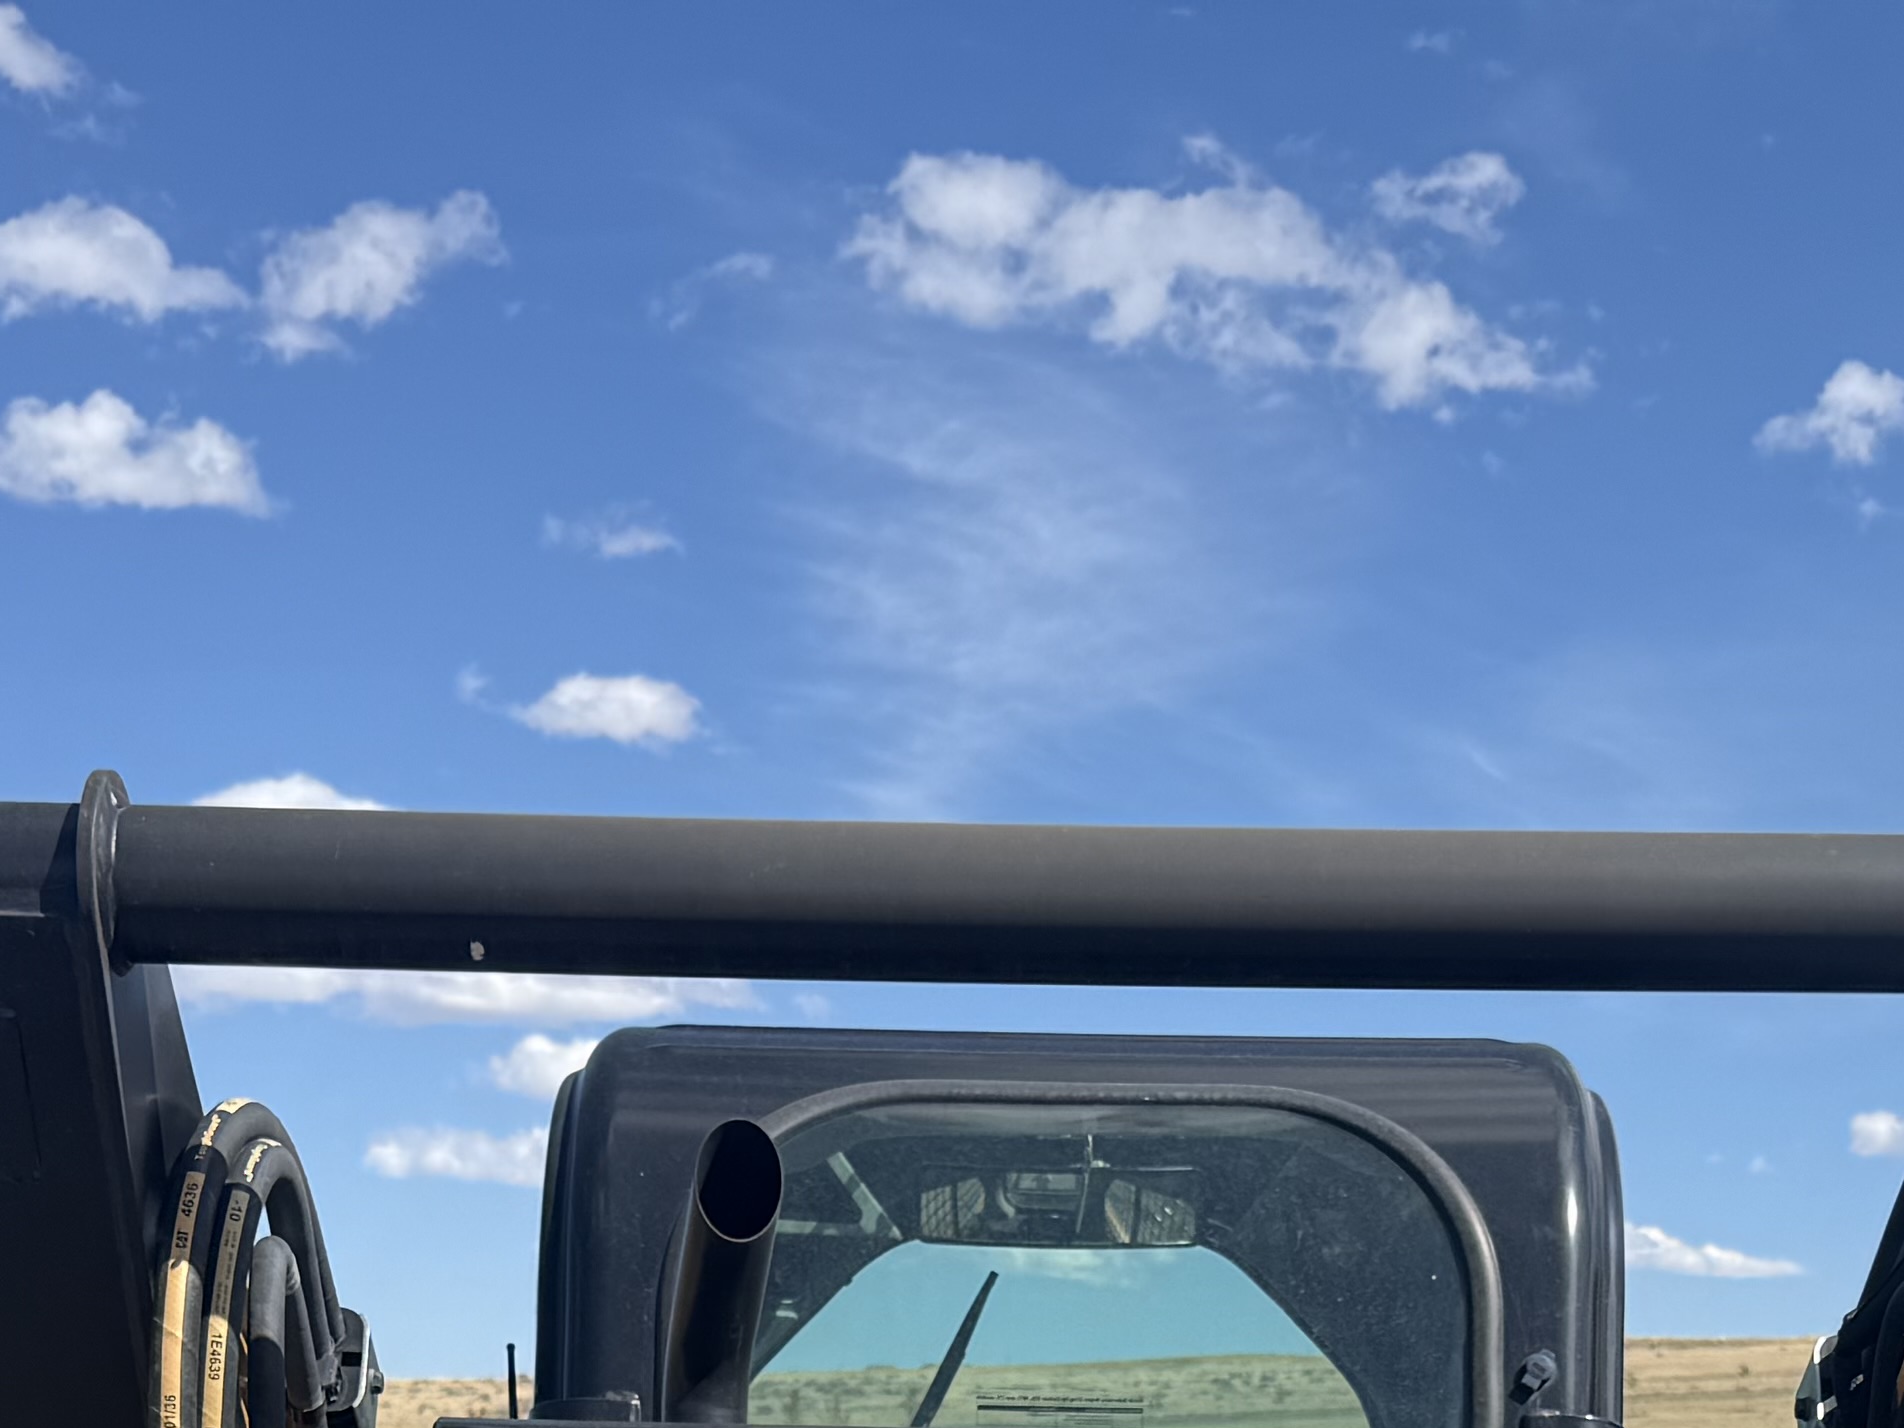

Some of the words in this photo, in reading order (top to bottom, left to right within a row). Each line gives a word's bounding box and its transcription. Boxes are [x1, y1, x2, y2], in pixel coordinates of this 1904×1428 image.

[181, 1182, 199, 1217] 4636
[229, 1199, 243, 1222] -10
[175, 1231, 189, 1248] CAT
[208, 1333, 223, 1381] 1E4639
